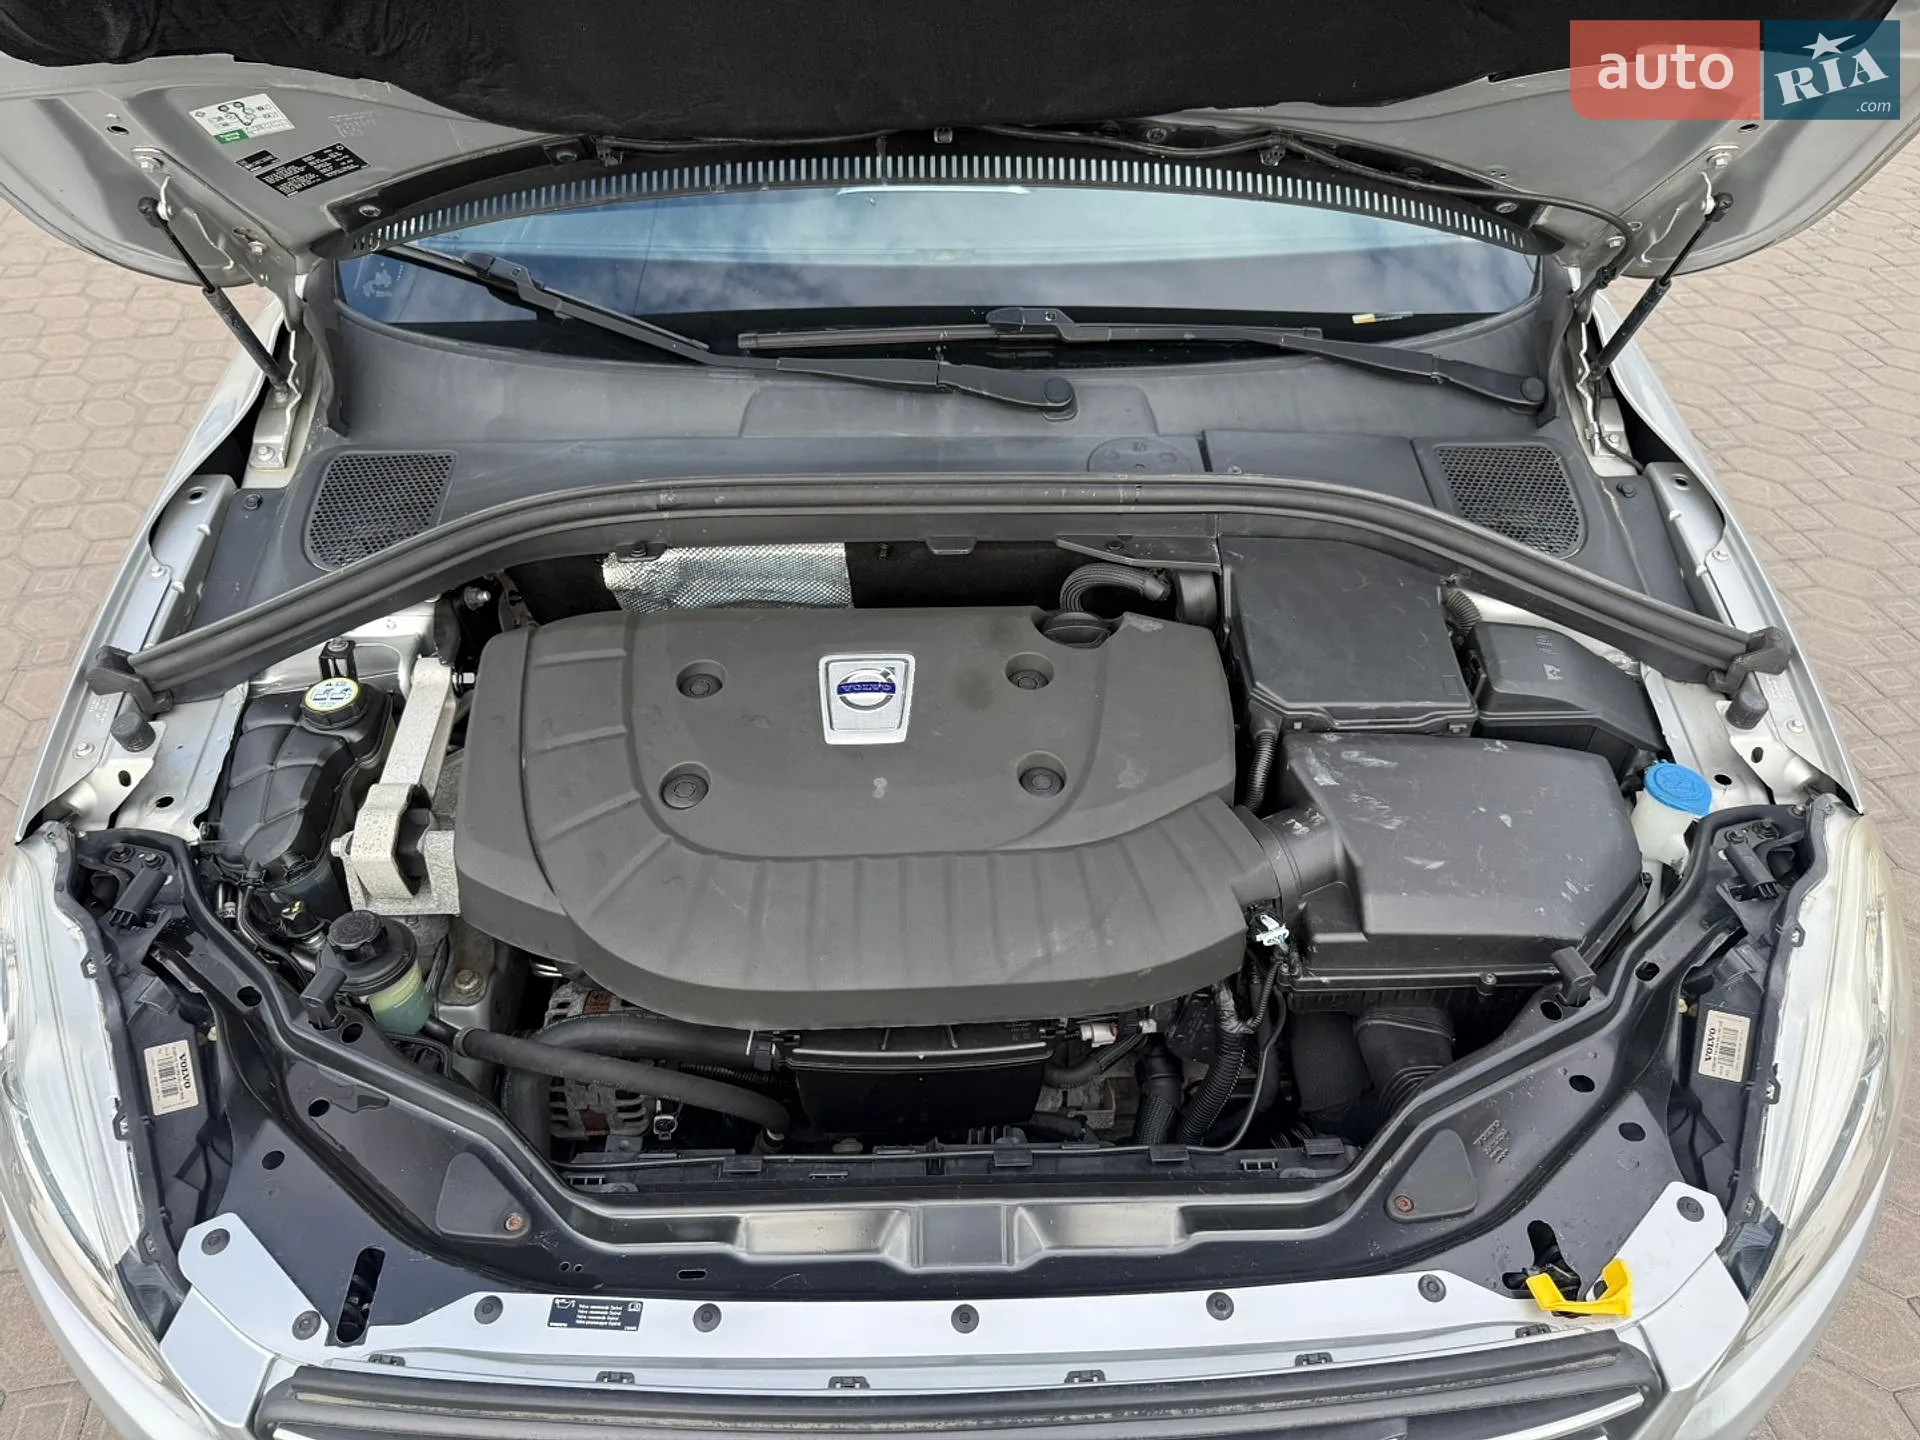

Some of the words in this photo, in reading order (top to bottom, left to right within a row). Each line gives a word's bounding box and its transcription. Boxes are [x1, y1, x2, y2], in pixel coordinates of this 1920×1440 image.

[840, 682, 893, 693] VOLVO
[1704, 1027, 1717, 1062] VOLVO
[178, 1053, 191, 1089] VOLVO
